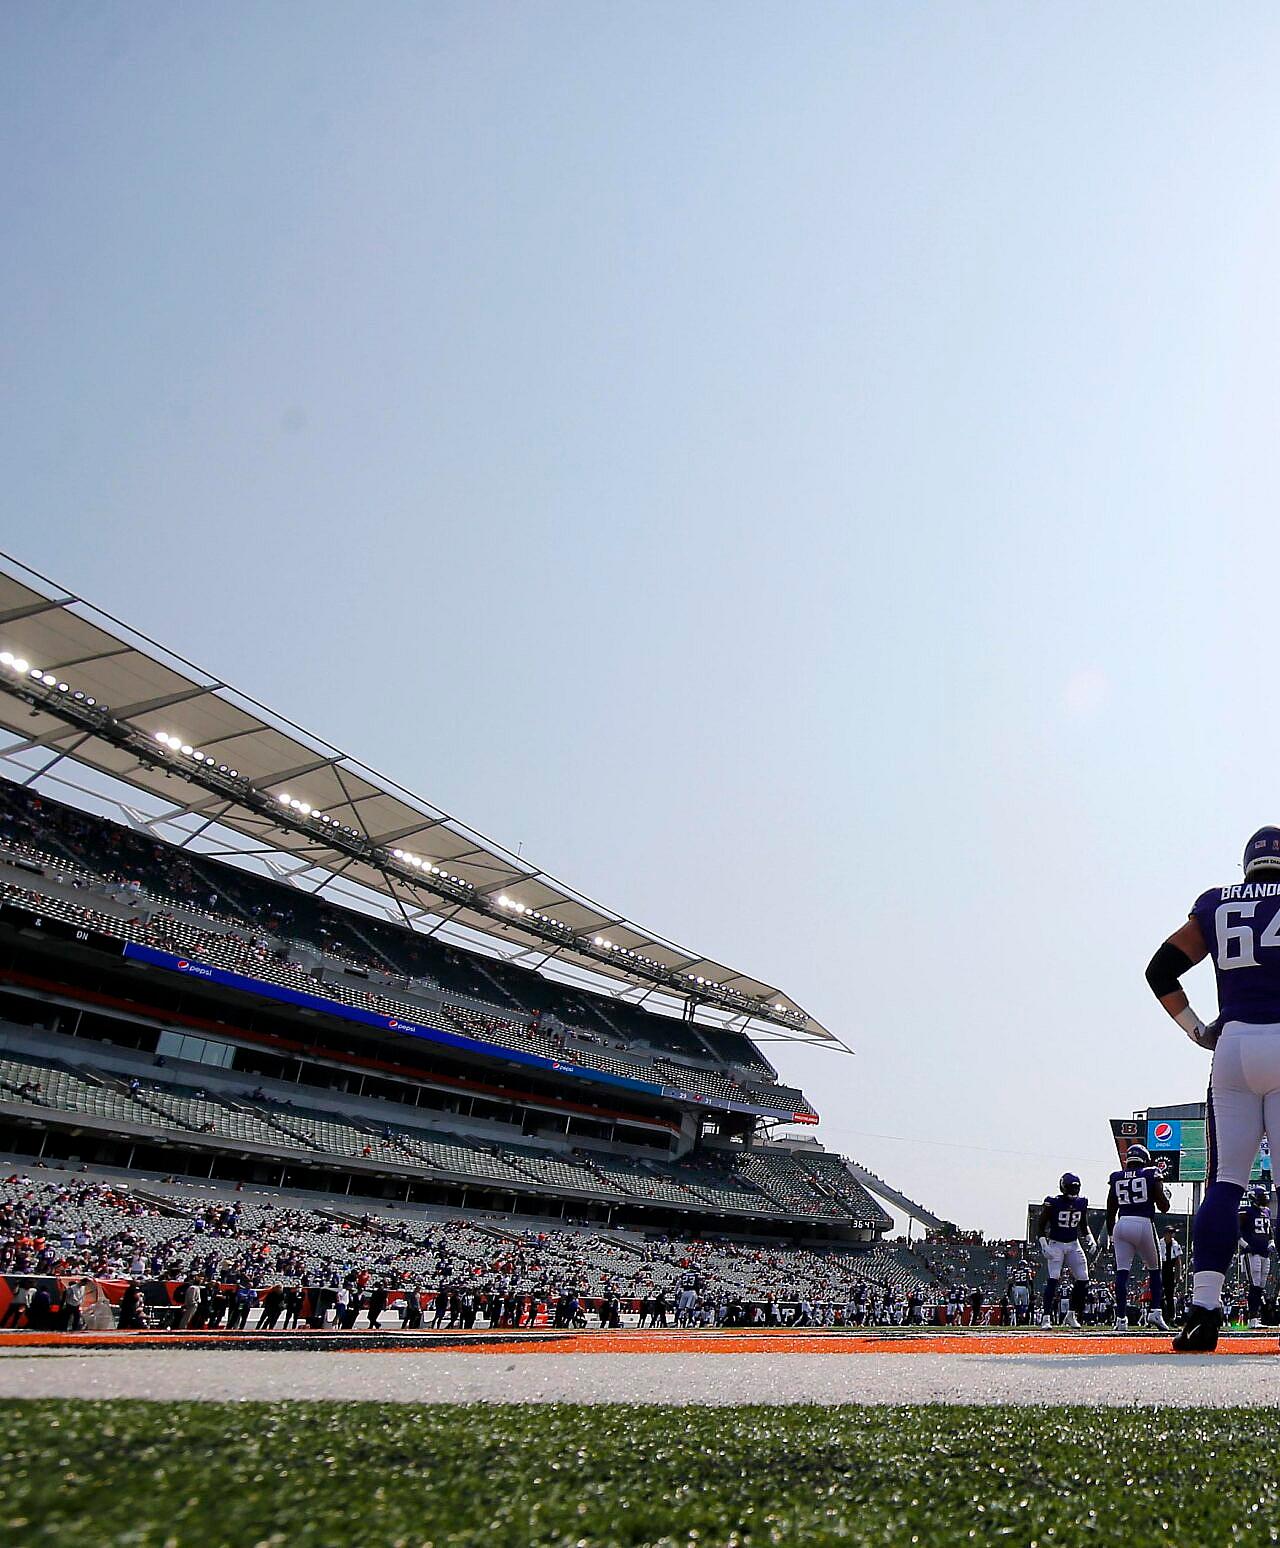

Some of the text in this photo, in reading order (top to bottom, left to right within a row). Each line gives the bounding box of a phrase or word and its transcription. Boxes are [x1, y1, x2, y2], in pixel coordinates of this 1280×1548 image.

[189, 964, 213, 976] pepsi
[397, 1024, 416, 1033] pepsi
[1124, 1171, 1137, 1179] HILL
[1115, 1177, 1148, 1205] 69
[1058, 1210, 1082, 1228] 98
[1254, 1217, 1271, 1234] 97
[681, 1276, 696, 1286] 23
[1014, 1273, 1027, 1282] 22
